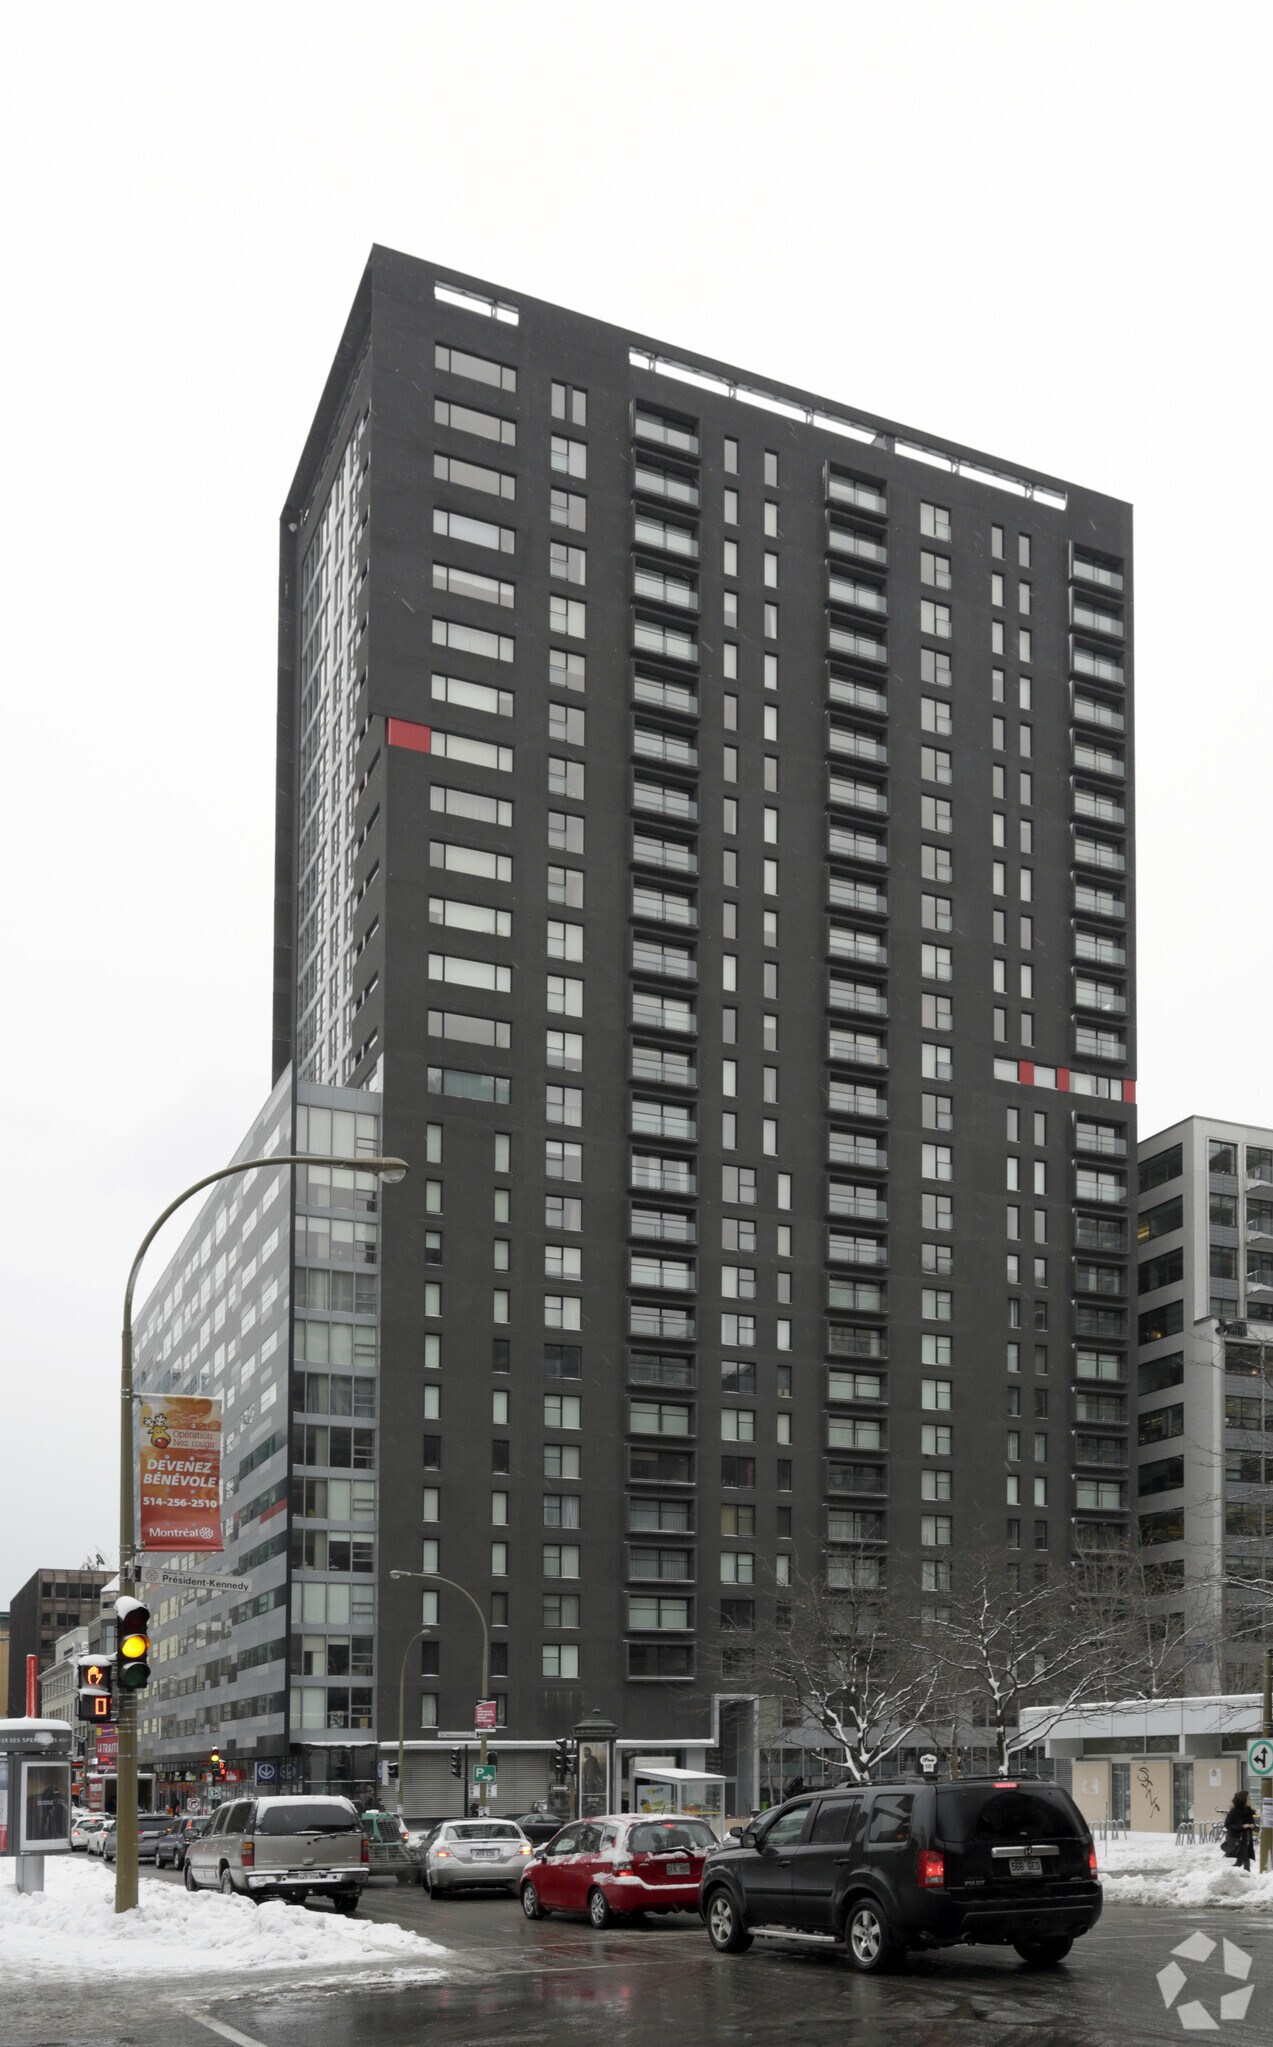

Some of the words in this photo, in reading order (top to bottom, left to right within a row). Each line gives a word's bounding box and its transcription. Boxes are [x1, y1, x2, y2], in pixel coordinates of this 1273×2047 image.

[173, 1431, 213, 1439] Opération
[173, 1439, 189, 1447] Nez
[191, 1441, 215, 1449] rouge
[147, 1459, 213, 1473] DEVENEZ
[143, 1472, 217, 1488] BÉNÉVOLE
[143, 1497, 217, 1508] 514-256-2510
[149, 1528, 199, 1537] Montréal
[162, 1575, 249, 1591] Président-Kennedy
[475, 1768, 485, 1778] P
